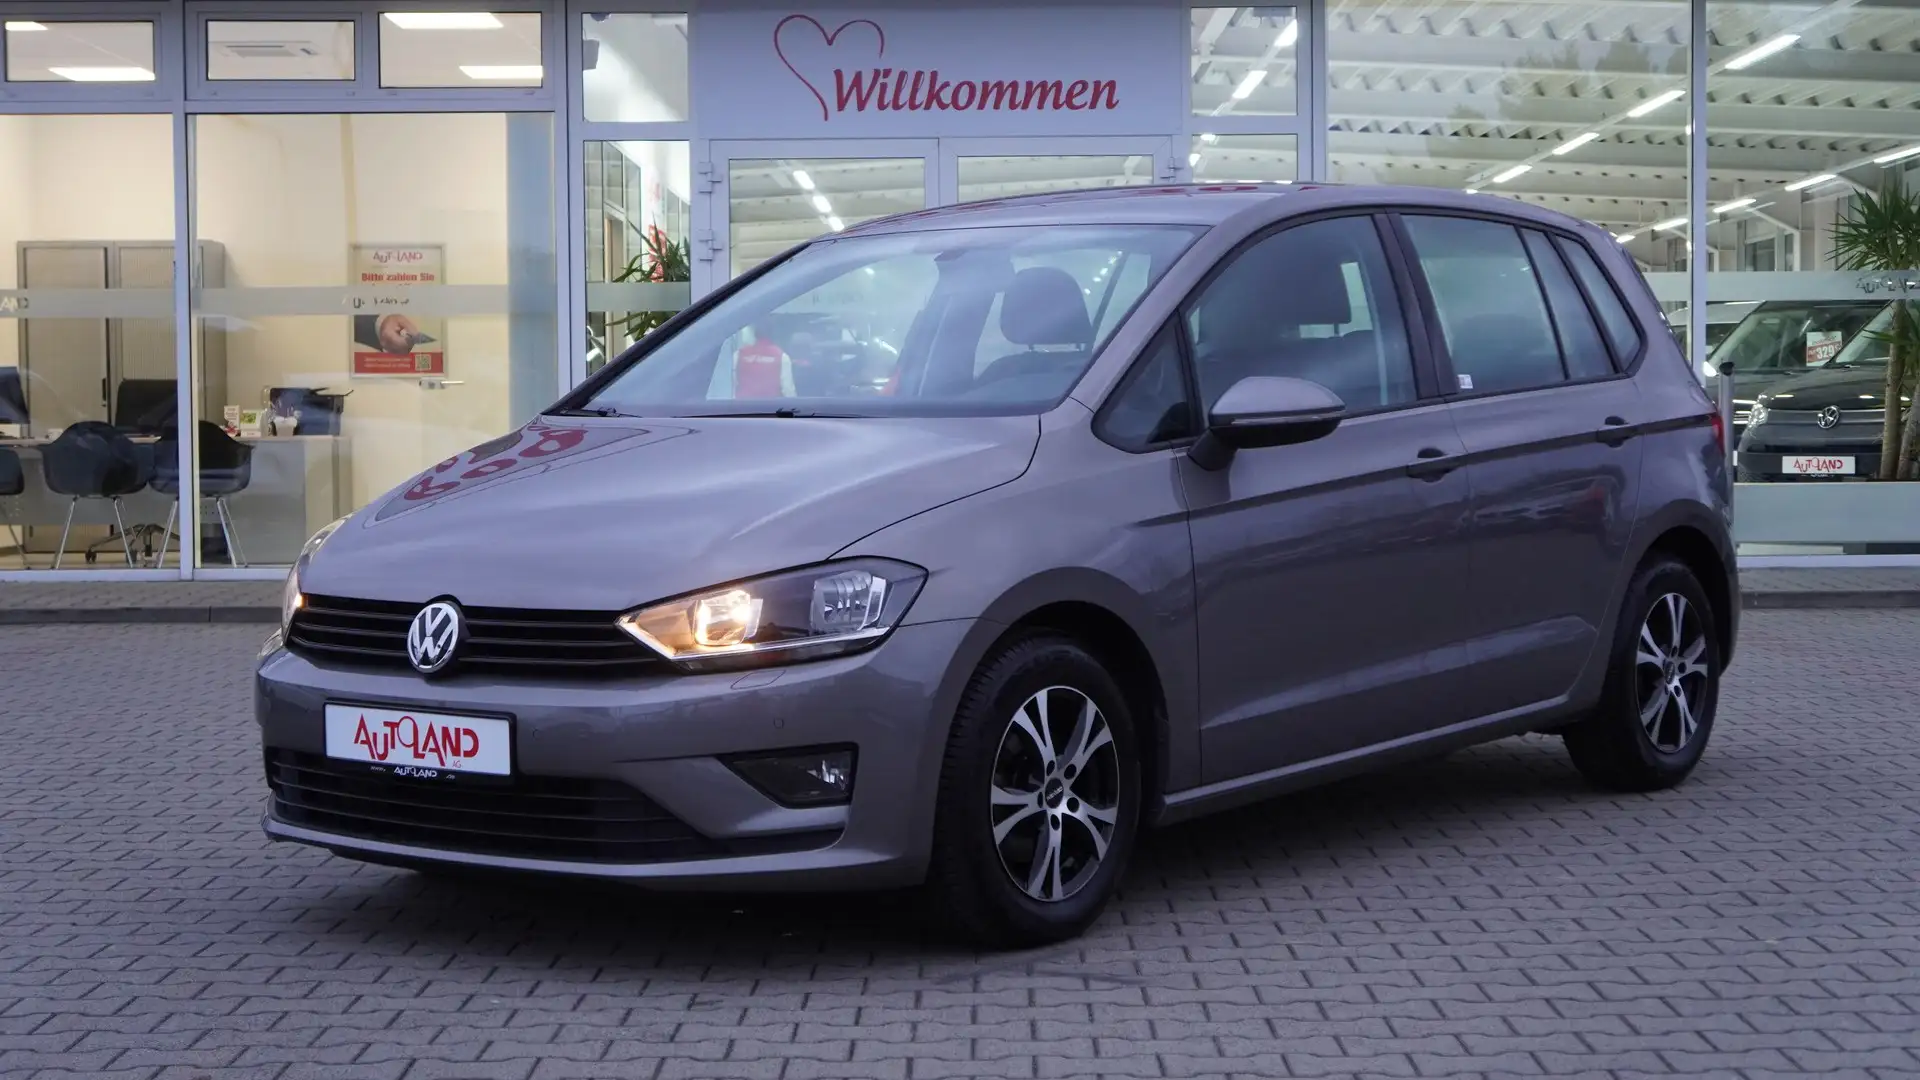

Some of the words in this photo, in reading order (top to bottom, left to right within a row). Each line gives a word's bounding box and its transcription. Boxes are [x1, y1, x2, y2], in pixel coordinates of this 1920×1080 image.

[833, 68, 1119, 112] Willkommen
[373, 250, 423, 263] AUTLAND
[361, 272, 385, 281] Bitte
[419, 272, 435, 281] Sie
[1816, 344, 1835, 360] 329
[1793, 457, 1843, 473] AUTOLAND
[354, 713, 479, 767] AUTOLAND
[394, 766, 437, 778] AUTOLAND
